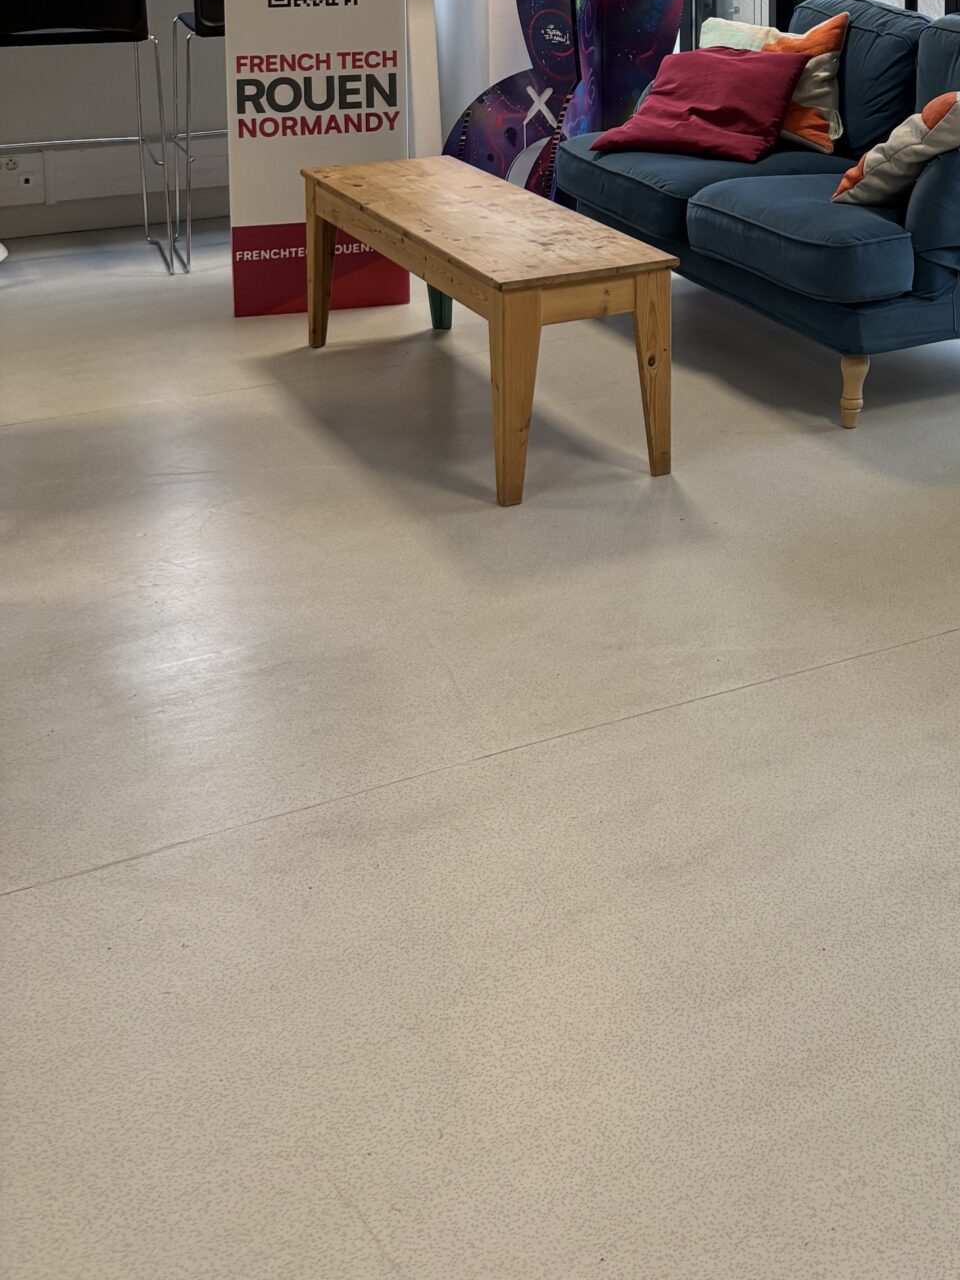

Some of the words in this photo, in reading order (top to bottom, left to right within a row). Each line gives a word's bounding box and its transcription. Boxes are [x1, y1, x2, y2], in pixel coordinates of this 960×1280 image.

[236, 53, 331, 73] FRENCH
[337, 50, 398, 69] TECH
[236, 73, 398, 114] ROUEN
[238, 111, 400, 139] NORMANDY
